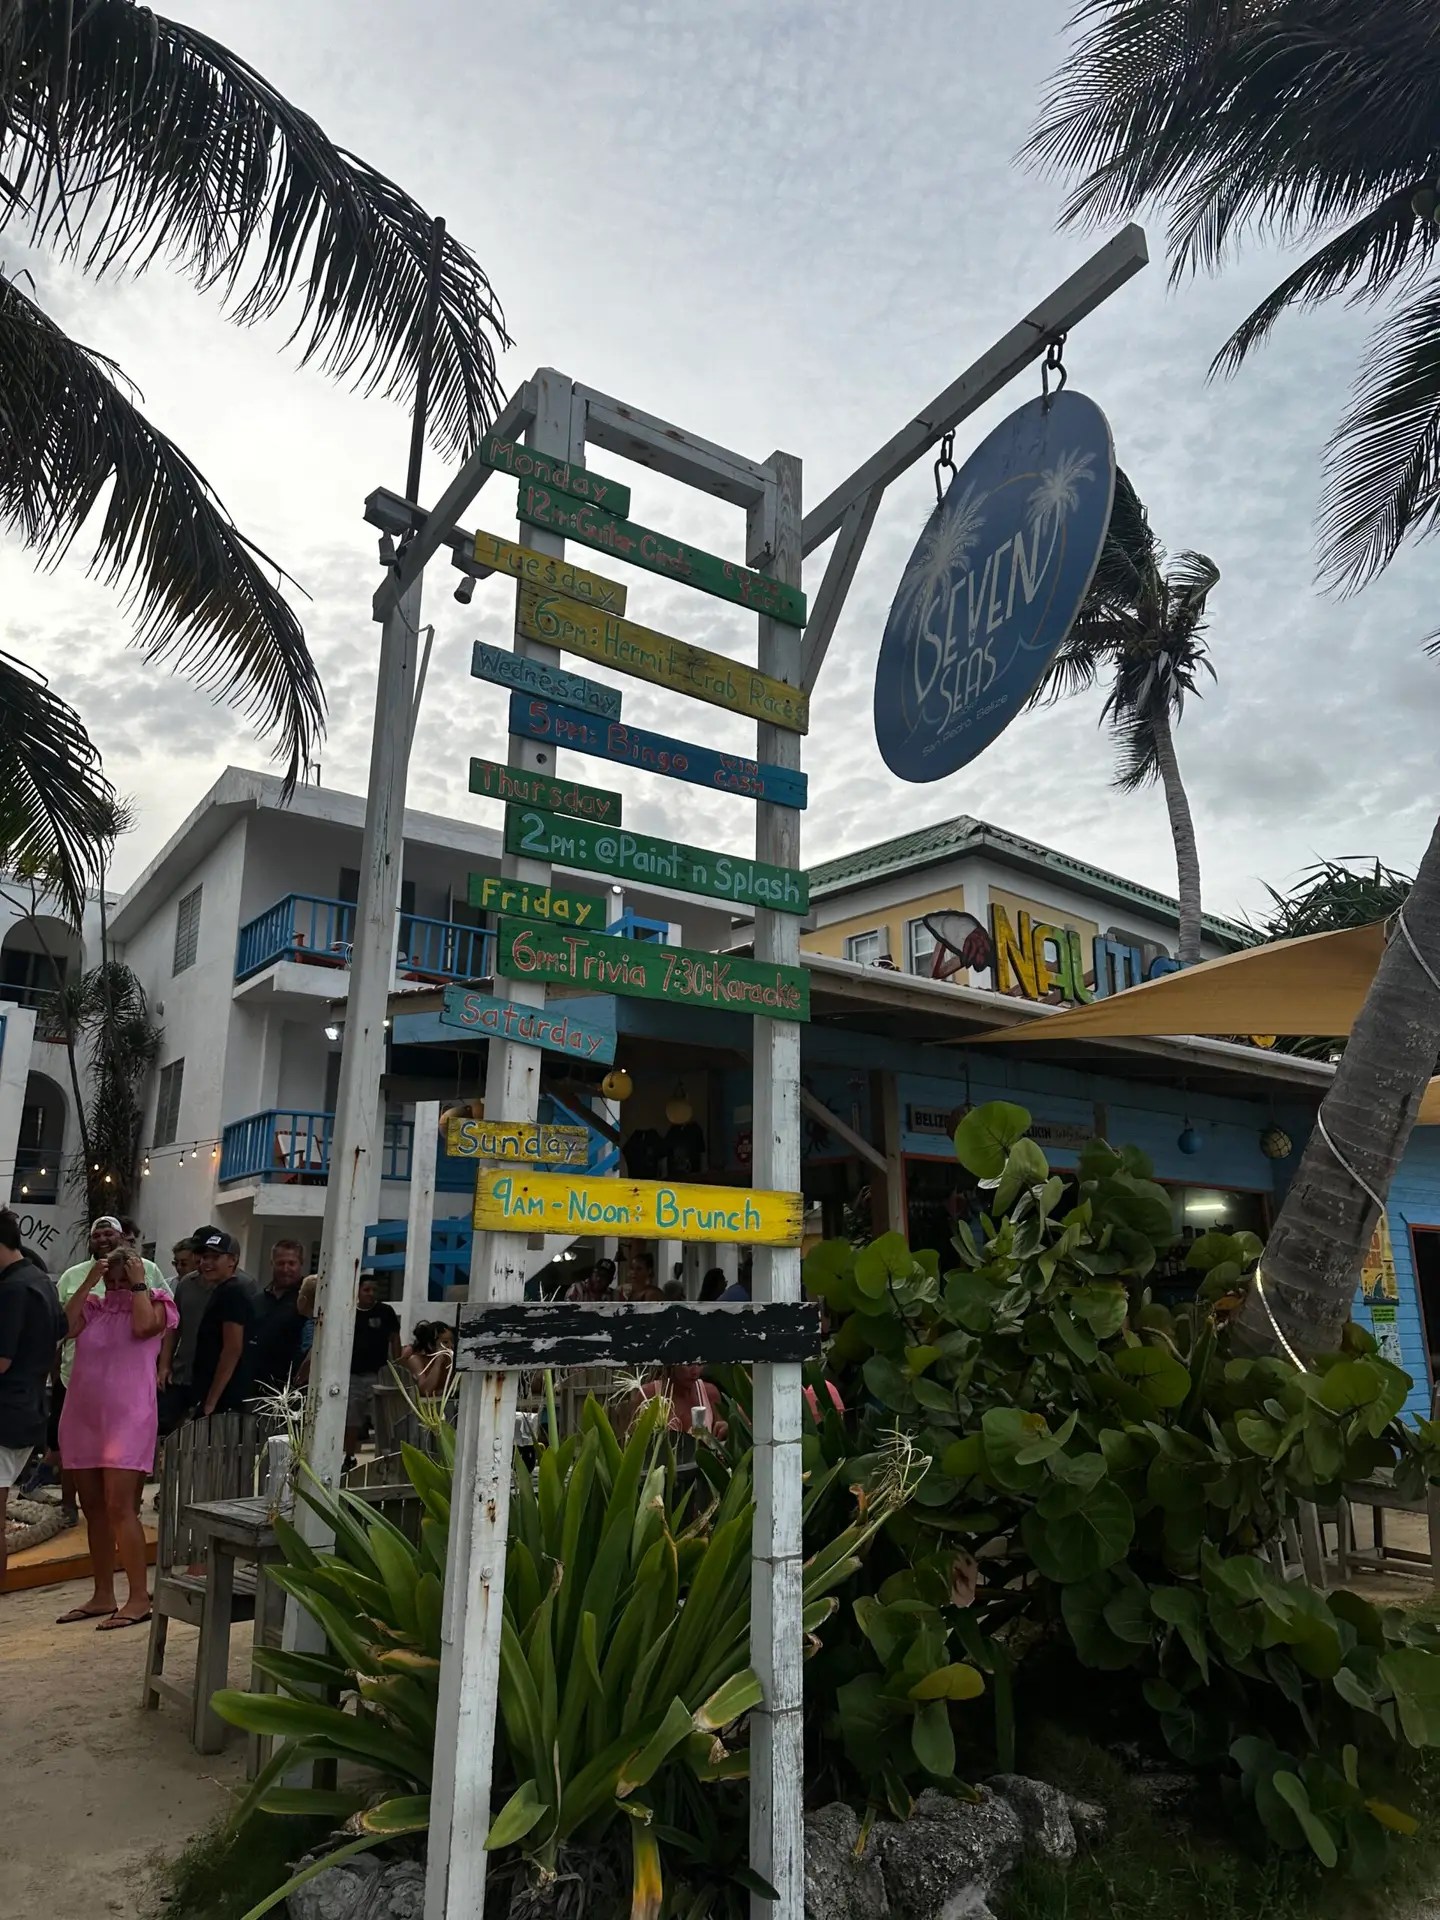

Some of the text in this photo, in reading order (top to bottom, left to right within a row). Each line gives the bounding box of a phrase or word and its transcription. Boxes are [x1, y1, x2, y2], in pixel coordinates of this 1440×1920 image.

[489, 437, 609, 503] Monday
[488, 537, 615, 607] Tuesday
[915, 514, 1042, 704] SEVEN
[477, 642, 617, 714] Wednesday
[604, 619, 677, 677] Hermit
[688, 661, 738, 700] Crab
[749, 676, 807, 726] Races
[937, 637, 997, 735] SEAS
[607, 722, 689, 773] Bingo
[476, 762, 612, 820] Thursday
[520, 812, 588, 860] 2PM:
[713, 857, 800, 904] Splash
[481, 878, 592, 927] Friday
[459, 994, 604, 1057] Saturday
[458, 1120, 578, 1166] Sunday
[18, 1214, 62, 1251] OME
[656, 1188, 762, 1233] Brunch
